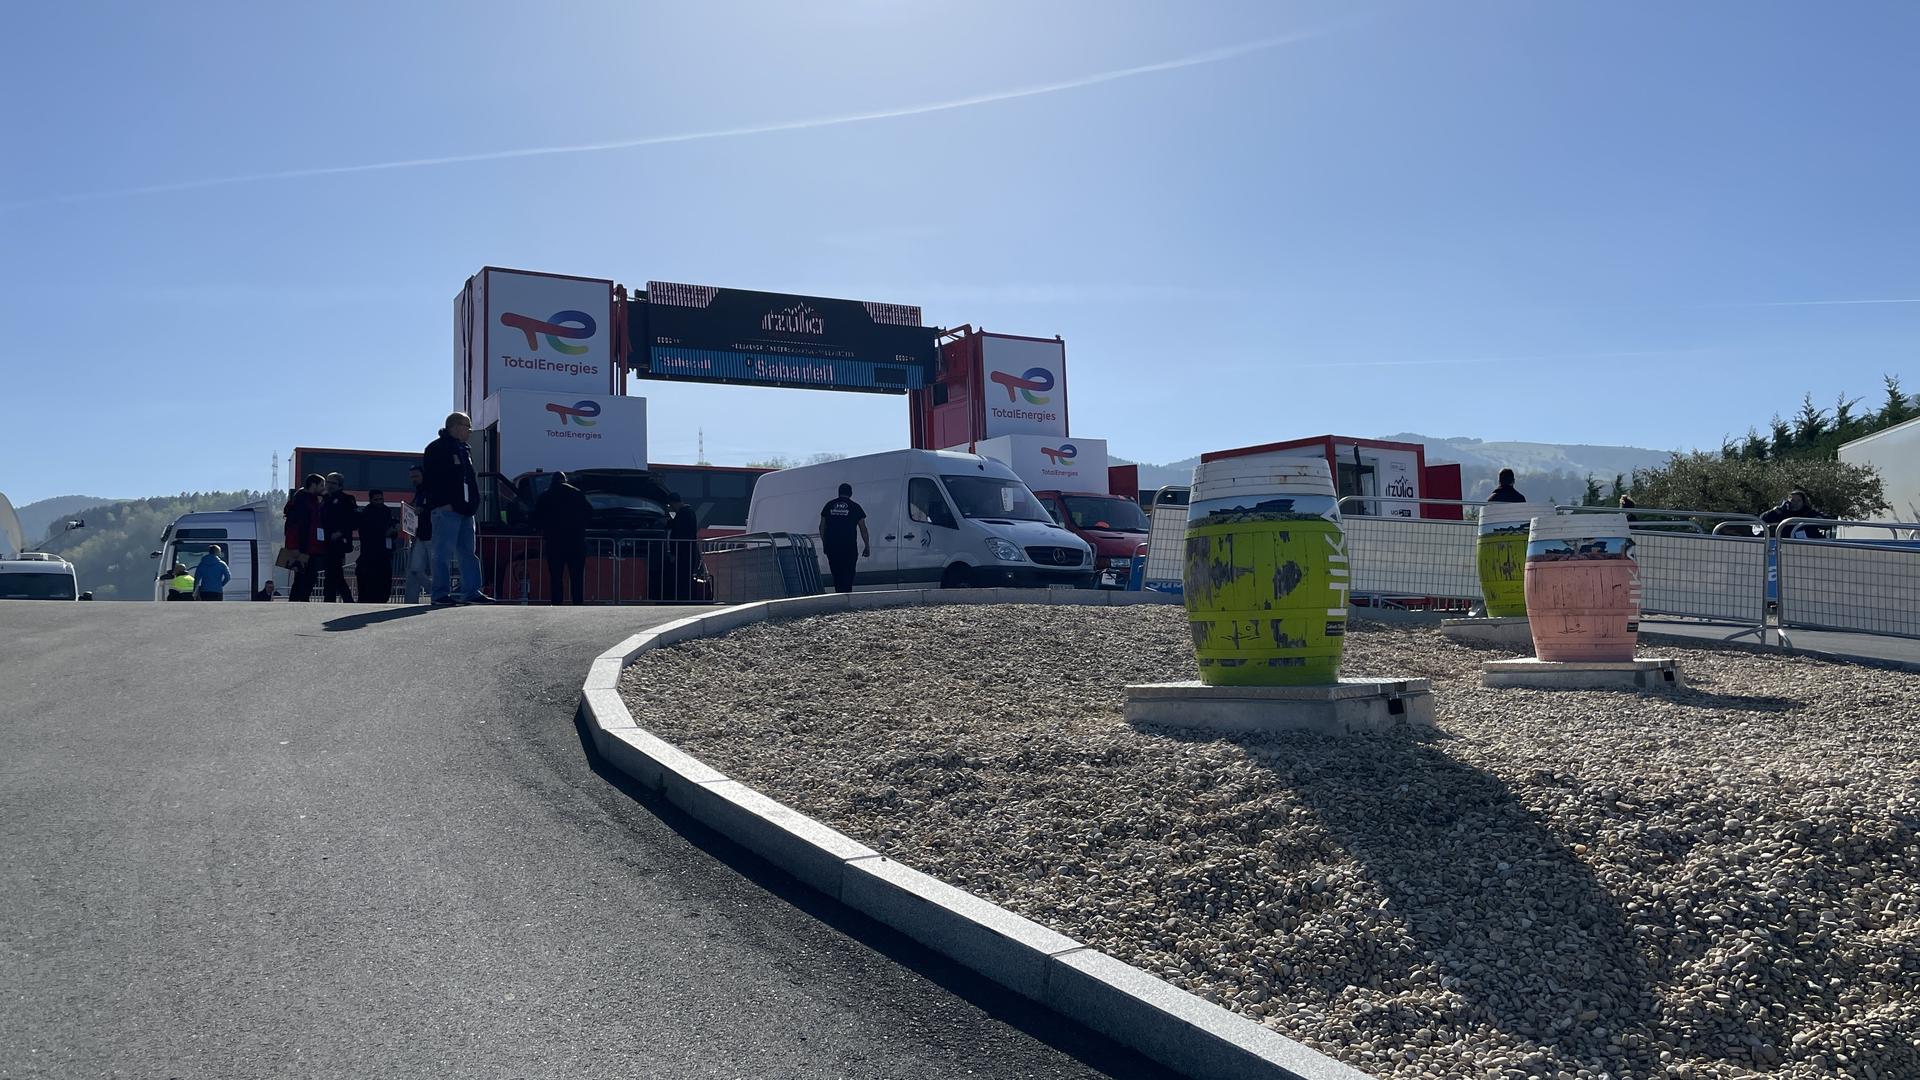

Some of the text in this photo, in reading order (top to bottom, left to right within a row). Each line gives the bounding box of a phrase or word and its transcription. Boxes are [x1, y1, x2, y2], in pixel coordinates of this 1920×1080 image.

[501, 355, 599, 376] TotalEnergies
[991, 407, 1056, 423] TotalEnergies
[546, 429, 602, 441] TotalEnergies
